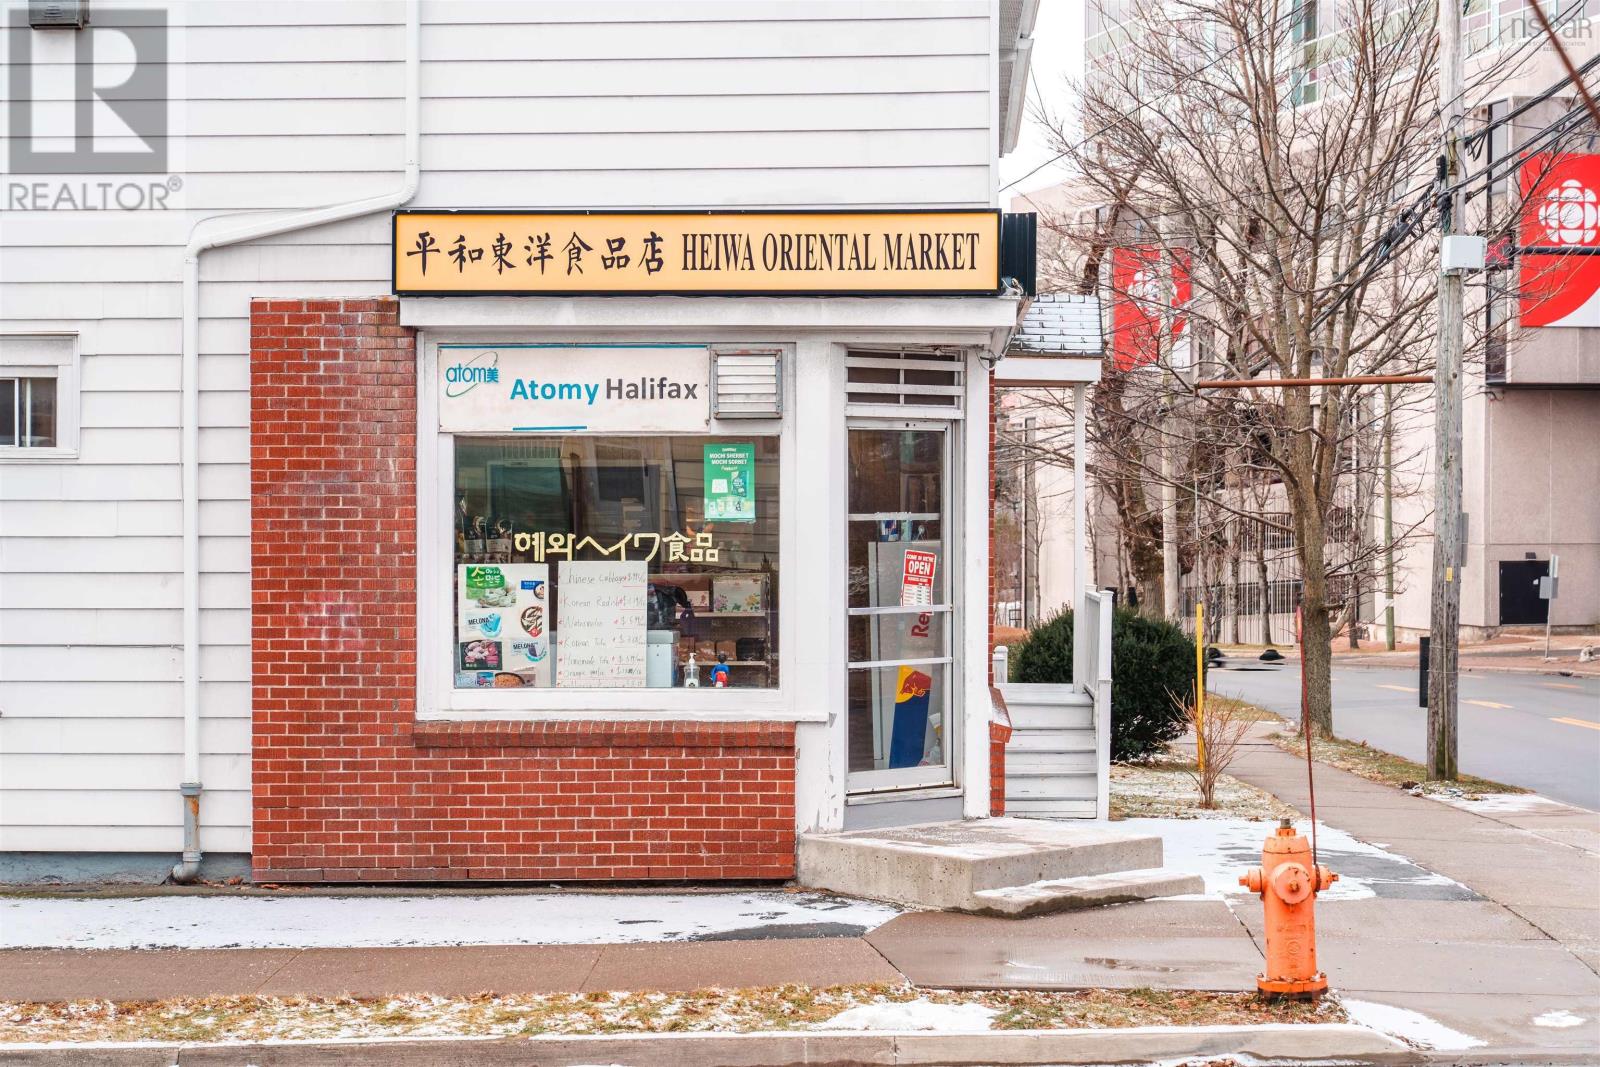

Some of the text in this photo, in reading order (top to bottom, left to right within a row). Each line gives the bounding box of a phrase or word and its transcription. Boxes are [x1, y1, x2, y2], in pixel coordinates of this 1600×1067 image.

[406, 231, 664, 276] 平和東洋食品店
[682, 232, 980, 271] HEIWA ORIENTAL MARKET
[510, 377, 698, 405] Atomy Halifax
[908, 560, 931, 576] OPEN
[468, 617, 490, 625] MELONA
